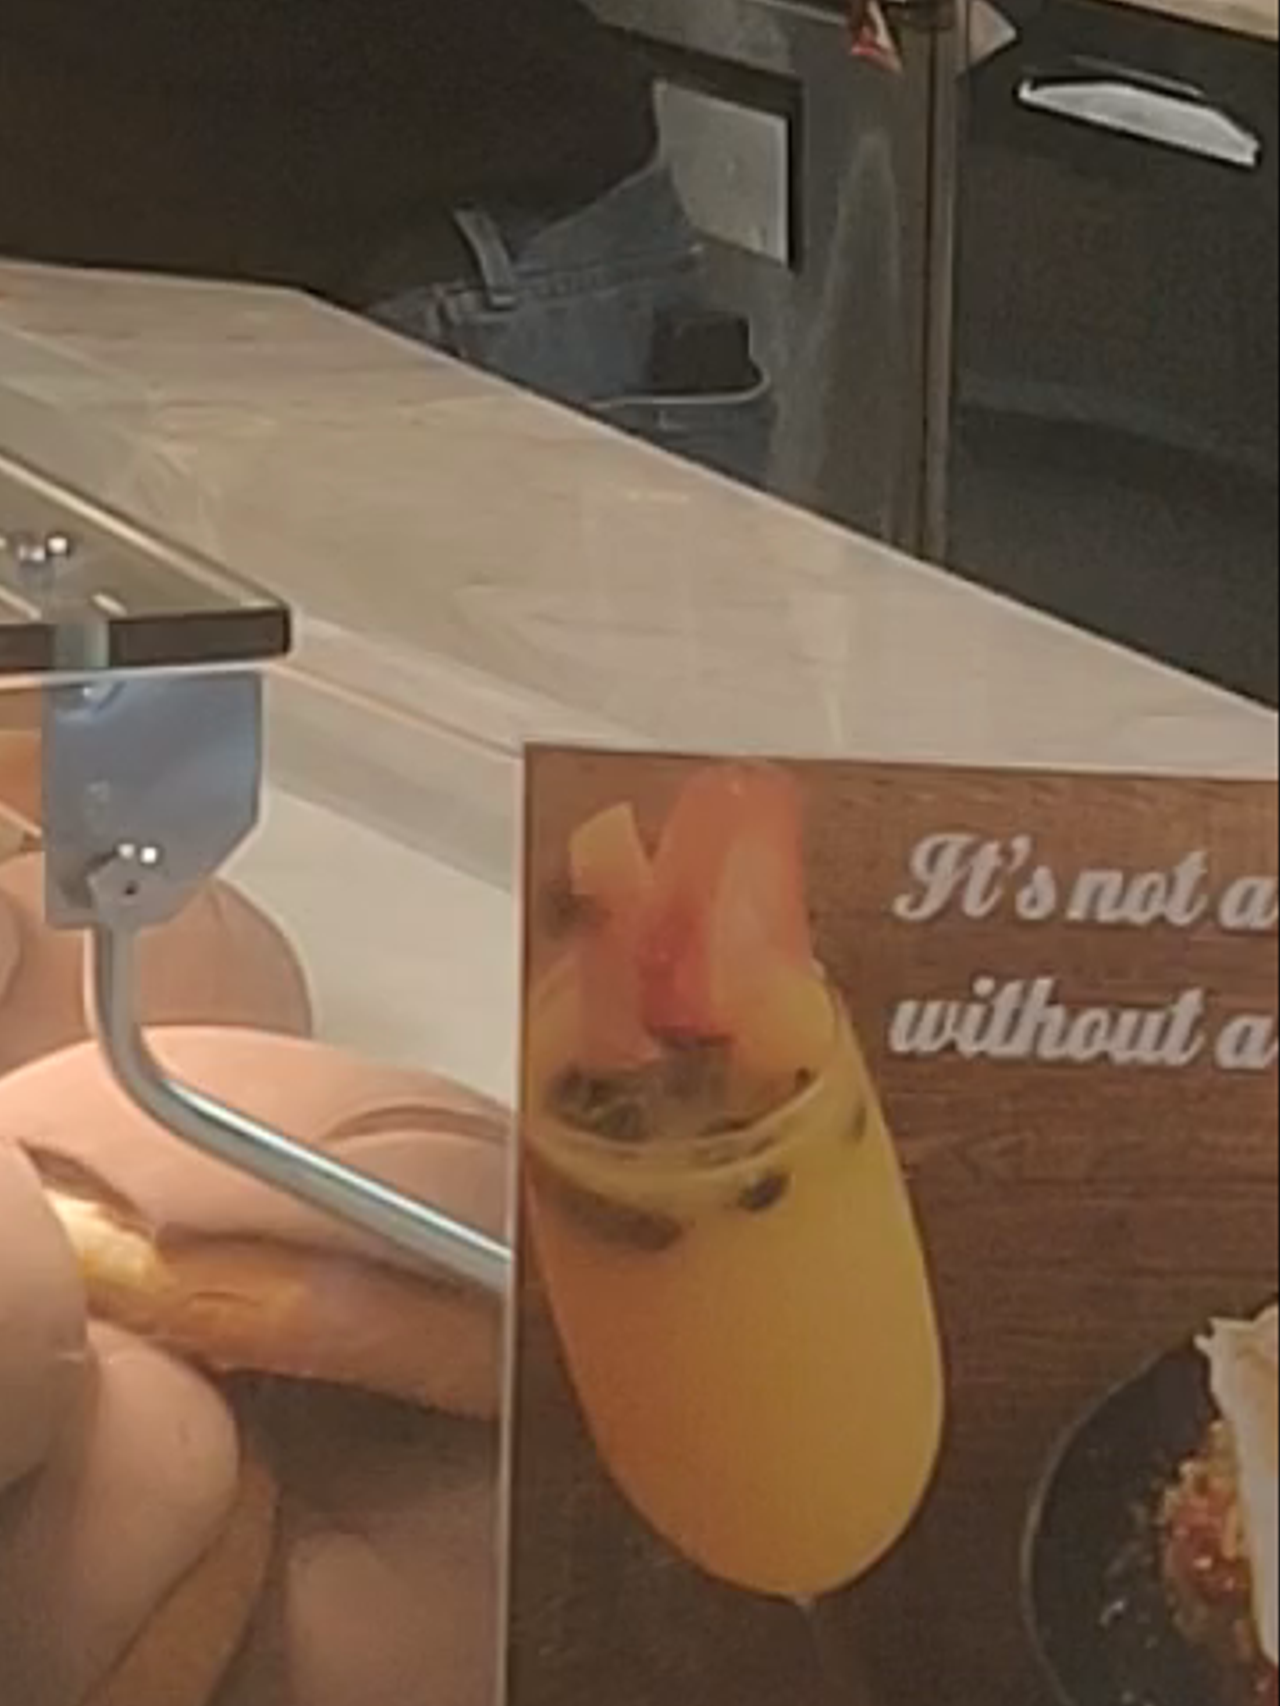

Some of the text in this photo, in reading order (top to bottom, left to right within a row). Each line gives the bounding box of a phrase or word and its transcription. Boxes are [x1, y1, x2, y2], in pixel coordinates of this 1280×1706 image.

[893, 832, 1277, 929] It's not a
[890, 976, 1277, 1069] without a
